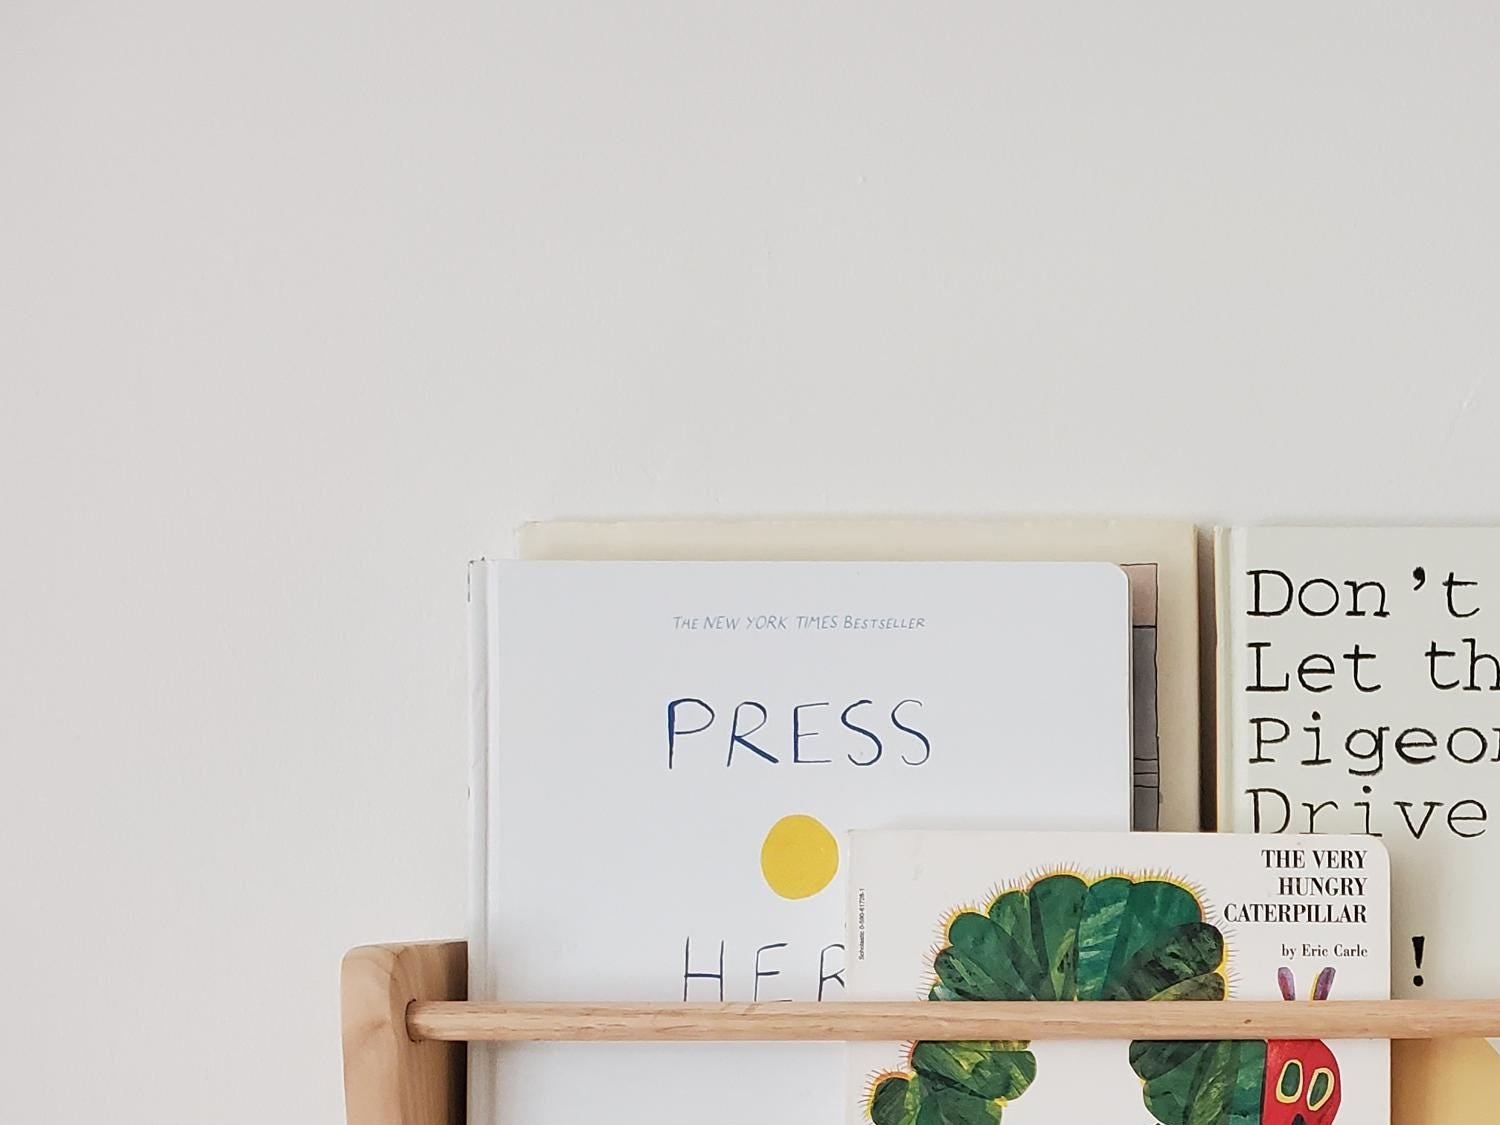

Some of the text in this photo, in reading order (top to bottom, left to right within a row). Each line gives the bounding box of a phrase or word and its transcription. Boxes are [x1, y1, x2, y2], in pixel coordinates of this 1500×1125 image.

[1246, 567, 1480, 618] Don't
[672, 615, 925, 630] THE NEW YORK TIMES BESTSELLER
[1246, 642, 1381, 692] Let
[668, 698, 930, 769] PRESS
[1245, 786, 1488, 838] Drive
[1262, 850, 1367, 868] THE VERY
[1280, 877, 1367, 896] HUNGRY
[1224, 904, 1366, 923] CATERPILLAR
[1282, 944, 1367, 959] by Eric Carle
